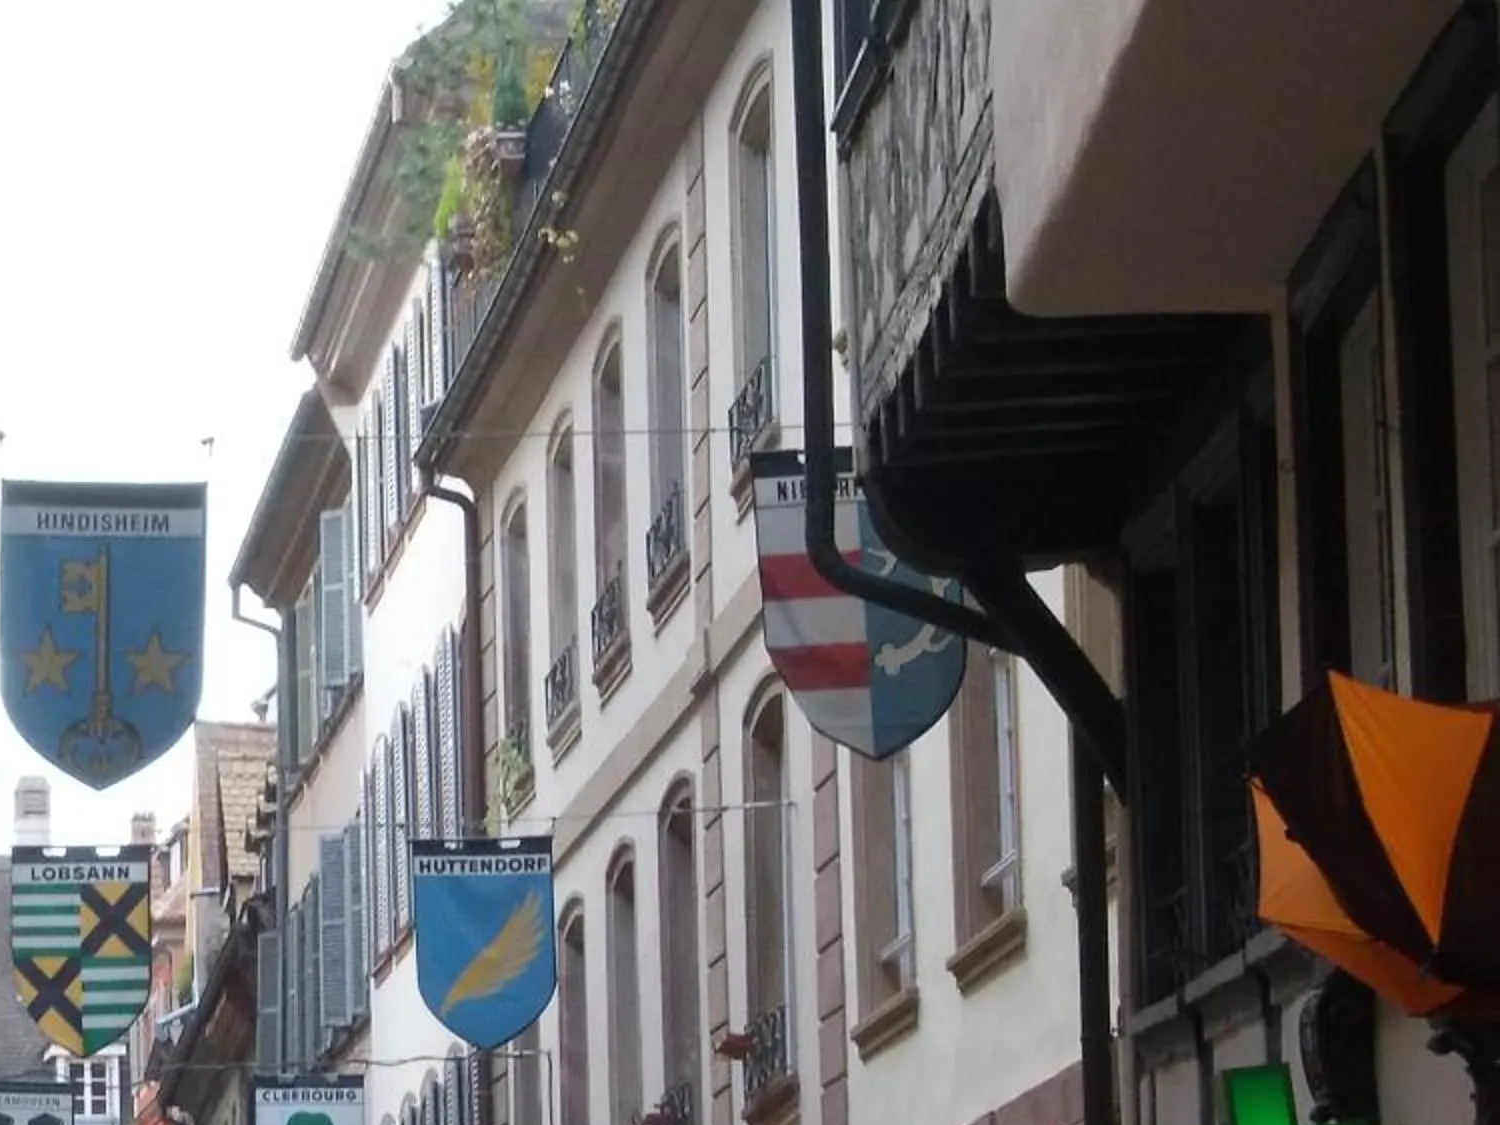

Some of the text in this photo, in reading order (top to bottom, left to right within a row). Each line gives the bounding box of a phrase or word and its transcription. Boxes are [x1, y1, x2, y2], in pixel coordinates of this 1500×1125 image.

[36, 511, 171, 533] HINDISHEIM
[29, 863, 132, 883] LOBSANN
[418, 857, 547, 874] HUTTENDORF
[261, 1089, 357, 1101] CLEEBOURG
